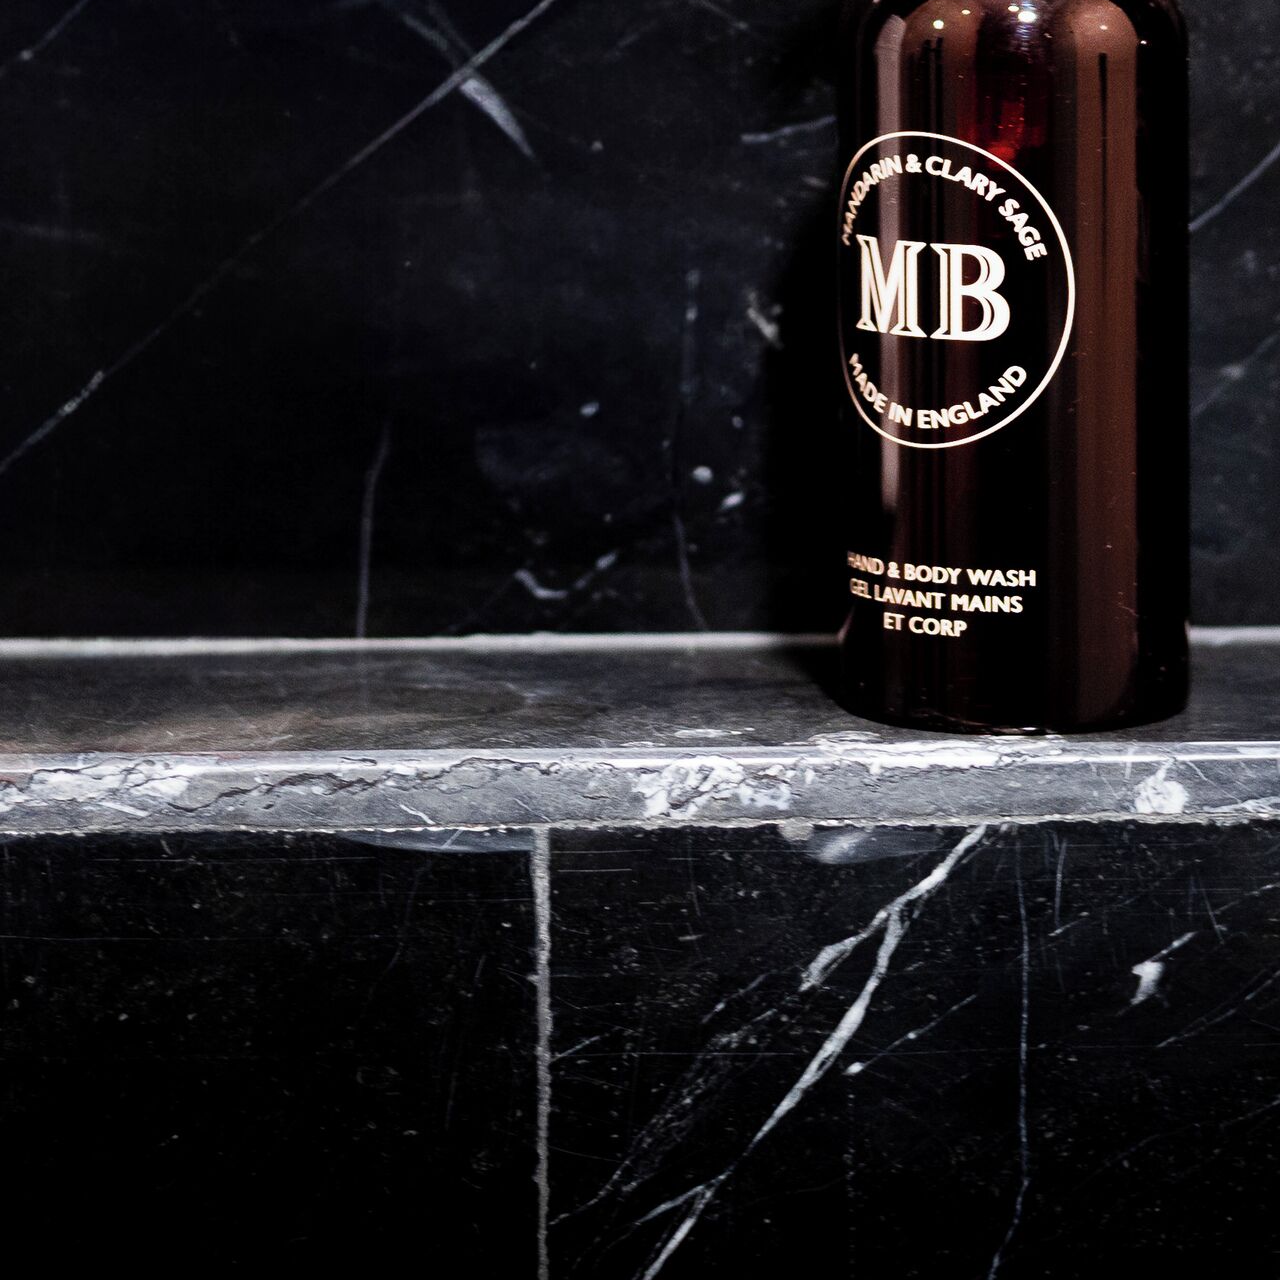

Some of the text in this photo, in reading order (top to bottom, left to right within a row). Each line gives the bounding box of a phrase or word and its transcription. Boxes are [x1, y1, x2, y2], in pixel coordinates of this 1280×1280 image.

[906, 153, 922, 173] &
[925, 155, 1006, 202] CLARY
[998, 198, 1048, 261] SAGE
[855, 233, 1011, 342] MB
[848, 353, 1028, 429] MADE IN ENGLAND
[850, 578, 1023, 613] GEL LAVANT MAINS
[887, 561, 900, 578] &
[904, 563, 962, 585] BODY
[967, 568, 1037, 587] WASH
[883, 612, 967, 637] ET CORP
